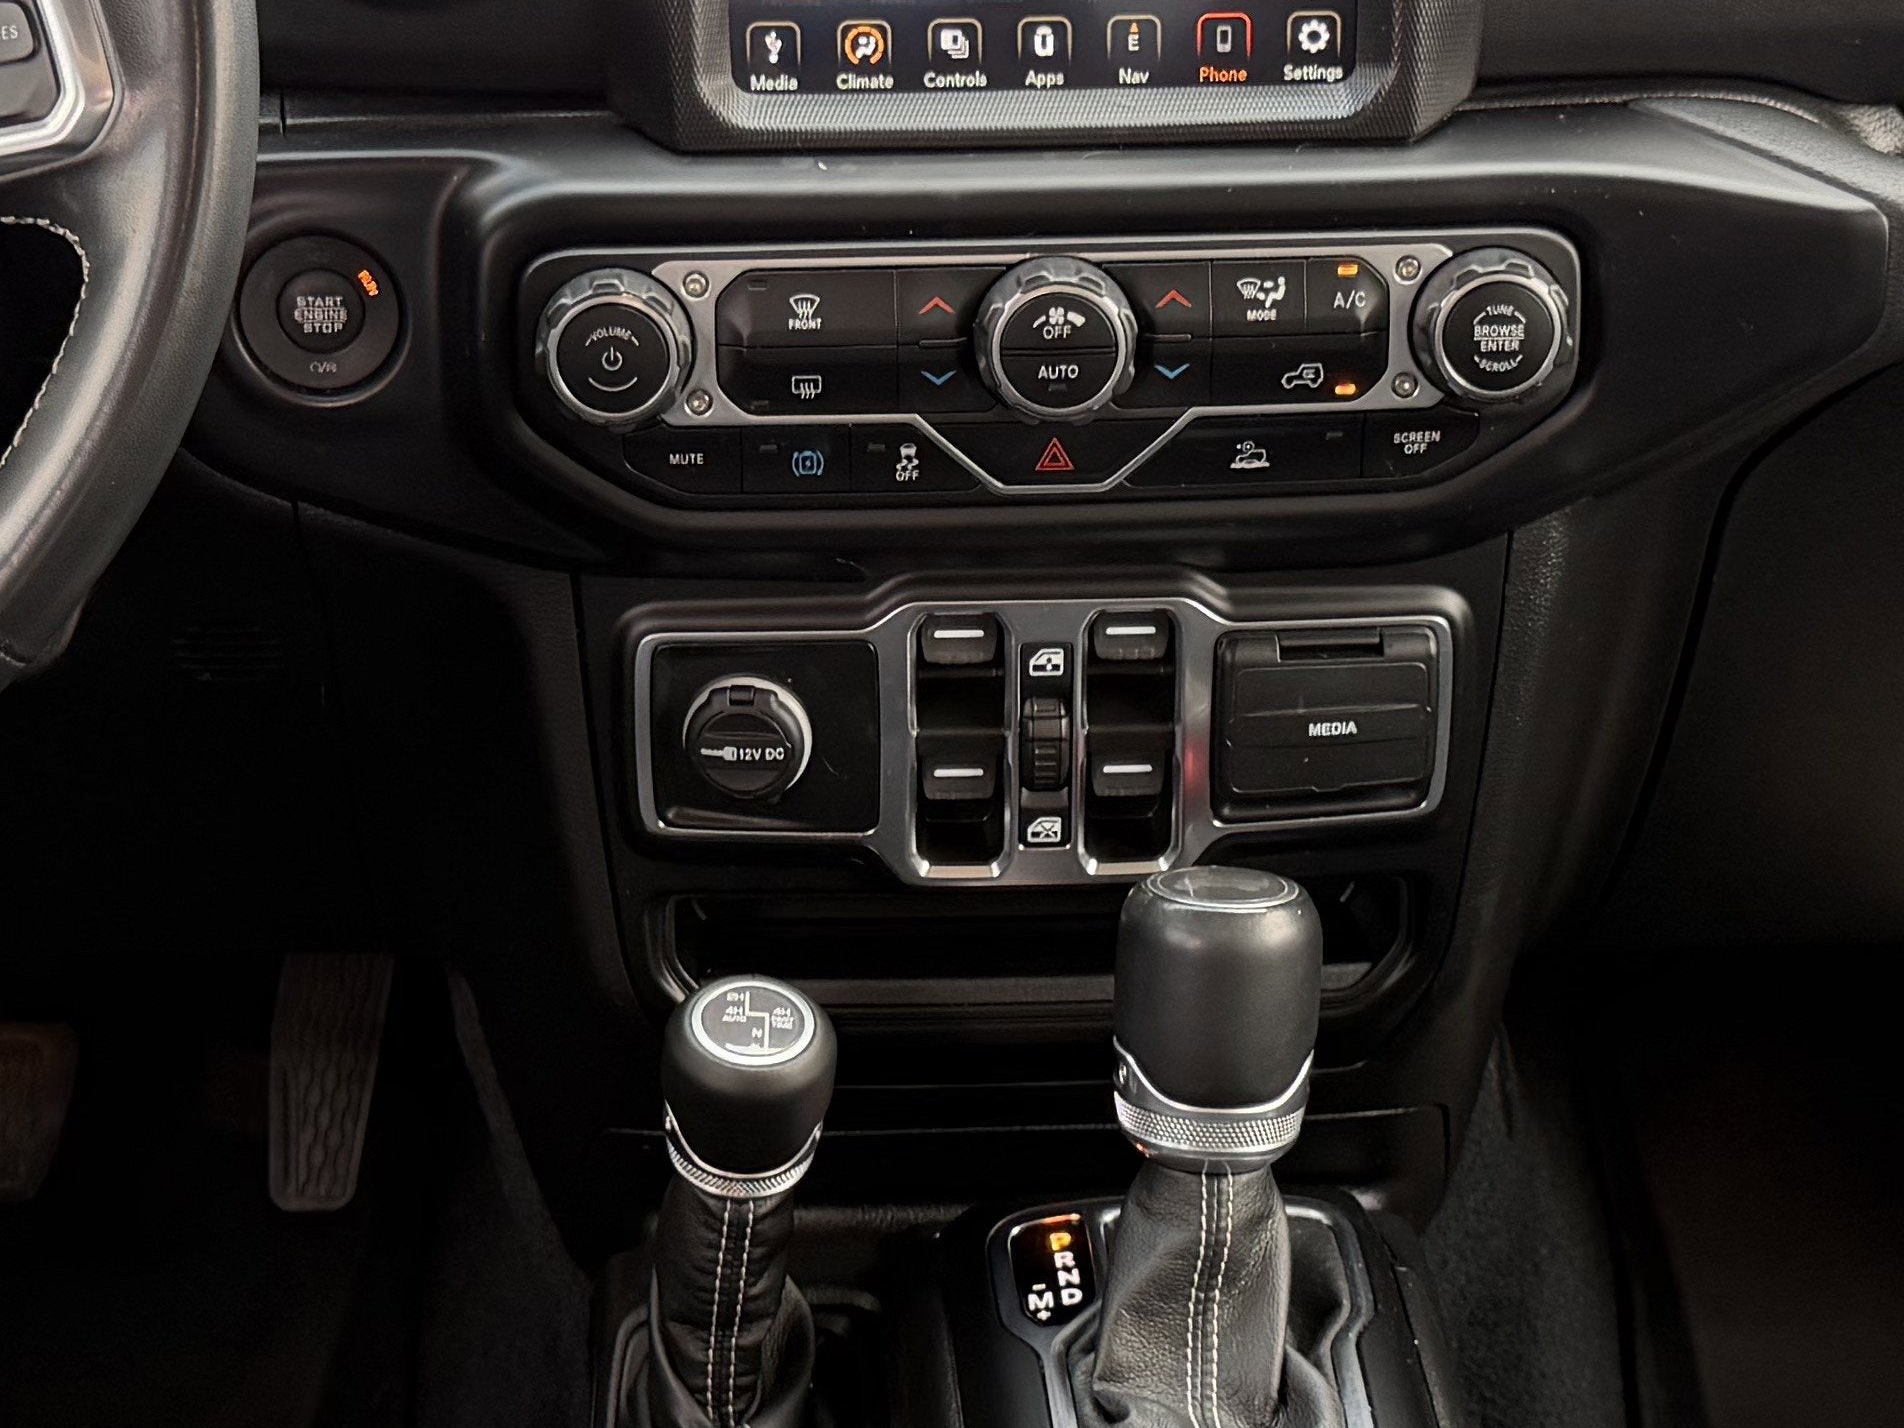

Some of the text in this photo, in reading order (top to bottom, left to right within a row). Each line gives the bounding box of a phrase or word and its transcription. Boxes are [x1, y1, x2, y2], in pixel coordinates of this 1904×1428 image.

[750, 72, 799, 92] Media
[836, 70, 894, 91] Climate
[923, 69, 987, 90] Controls
[1025, 69, 1064, 90] Apps
[1118, 66, 1149, 86] Nav
[1199, 64, 1247, 84] Phone
[1283, 63, 1343, 86] Settings
[296, 296, 343, 307] START
[1333, 291, 1367, 310] A/C
[294, 308, 347, 321] ENGINE
[1246, 309, 1277, 321] MODE
[1486, 304, 1514, 316] TUNE
[303, 322, 343, 334] STOP
[788, 318, 823, 330] FRONT
[1043, 324, 1072, 340] OFF
[1474, 324, 1525, 337] BROWSE
[591, 326, 632, 342] VOLUME
[1480, 340, 1520, 353] ENTER
[1037, 363, 1079, 381] AUTO
[1478, 358, 1519, 372] SCROLL
[1393, 429, 1440, 445] SCREEN
[1403, 441, 1428, 456] OFF
[669, 454, 704, 465] MUTE
[895, 468, 920, 482] OFF
[1308, 718, 1358, 738] MEDIA
[739, 744, 785, 761] 12V DC
[1049, 1232, 1072, 1252] P
[1054, 1251, 1075, 1268] R
[1057, 1268, 1081, 1286] N
[1027, 1290, 1054, 1311] M
[1061, 1287, 1082, 1306] D
